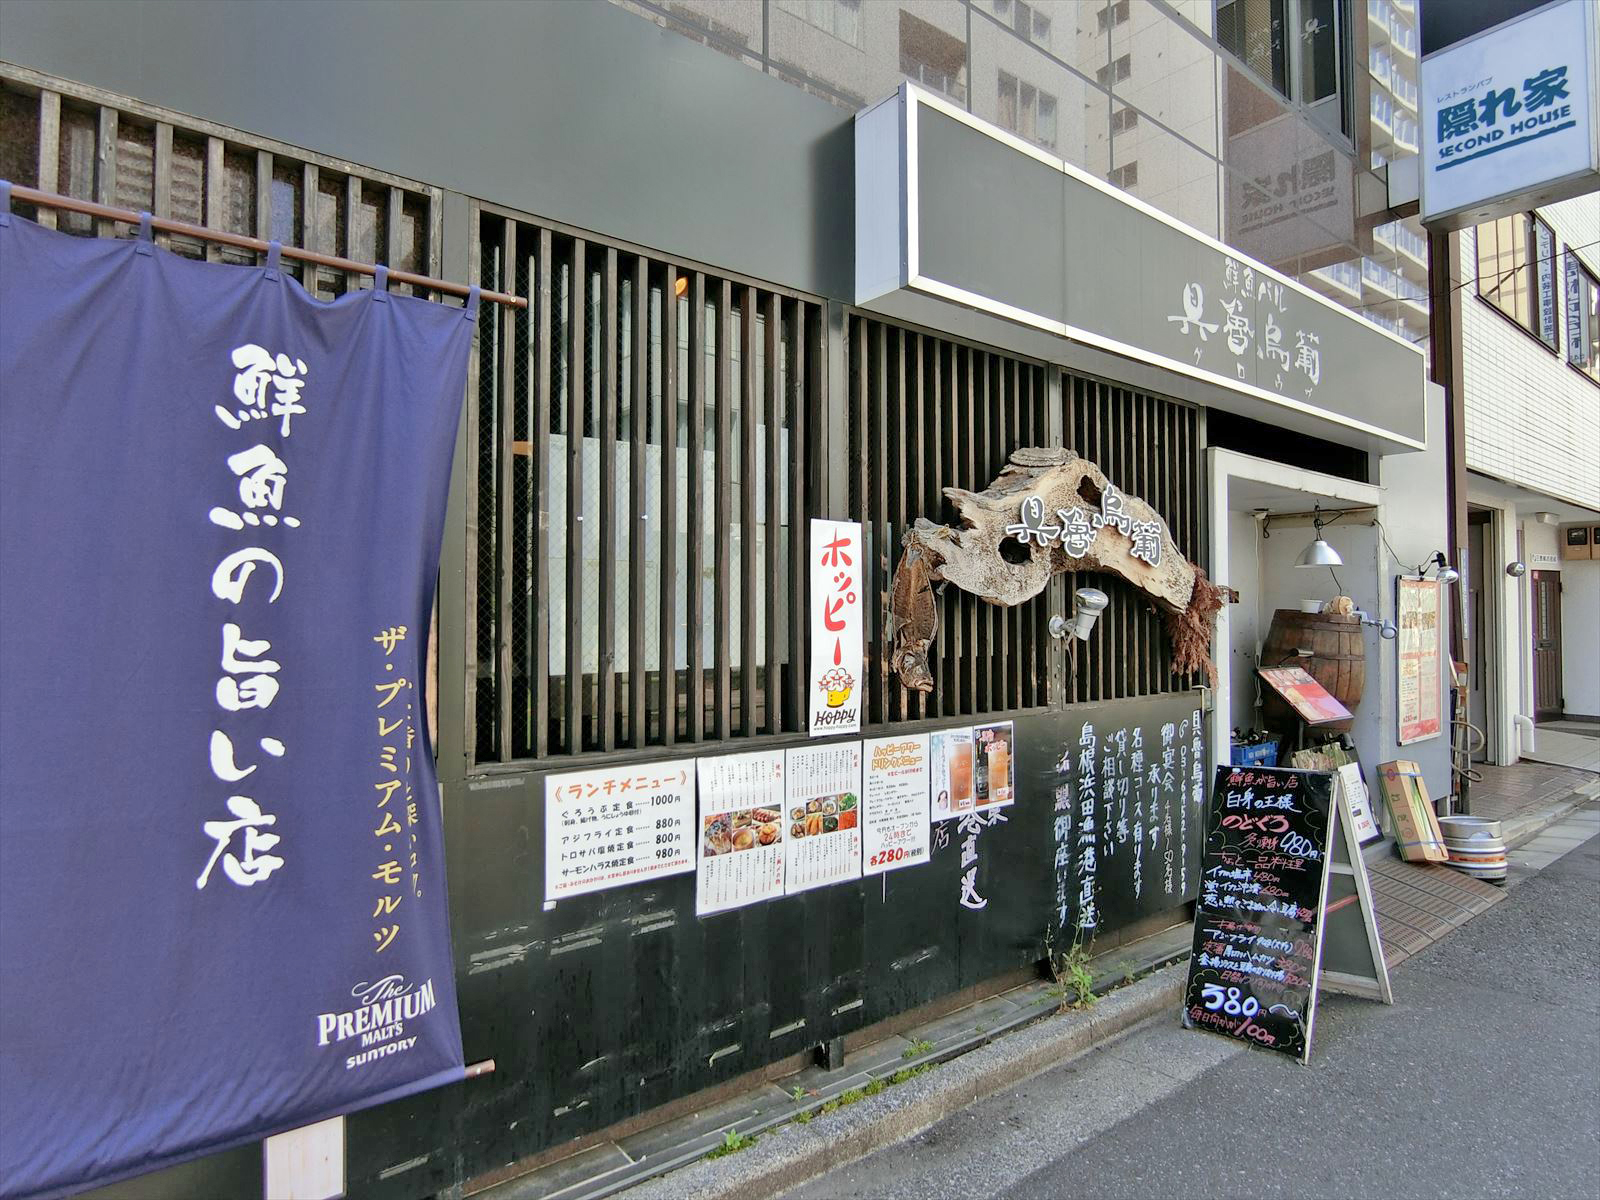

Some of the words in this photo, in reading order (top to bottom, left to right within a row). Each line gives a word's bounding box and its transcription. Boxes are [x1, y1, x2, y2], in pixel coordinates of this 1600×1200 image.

[1437, 66, 1570, 143] 隠れ家
[1439, 129, 1504, 158] SECOND
[1511, 105, 1571, 135] HOUSE
[821, 528, 857, 666] ホッピー
[195, 343, 309, 890] 鮮魚の旨い店
[872, 756, 922, 771] ドリンクメニュー
[873, 742, 921, 757] ハッピーアワー
[1160, 723, 1176, 792] 御宴会
[372, 625, 408, 953] ザ・プレミアム・モルツ
[1226, 788, 1302, 813] 白身の王様
[562, 826, 634, 844] アジフライ定食
[655, 818, 681, 830] 880円
[1222, 814, 1290, 833] のどぐろ
[655, 847, 681, 860] 980円
[1280, 831, 1318, 859] 980円
[352, 975, 414, 1005] The
[317, 978, 436, 1046] PREMIUM
